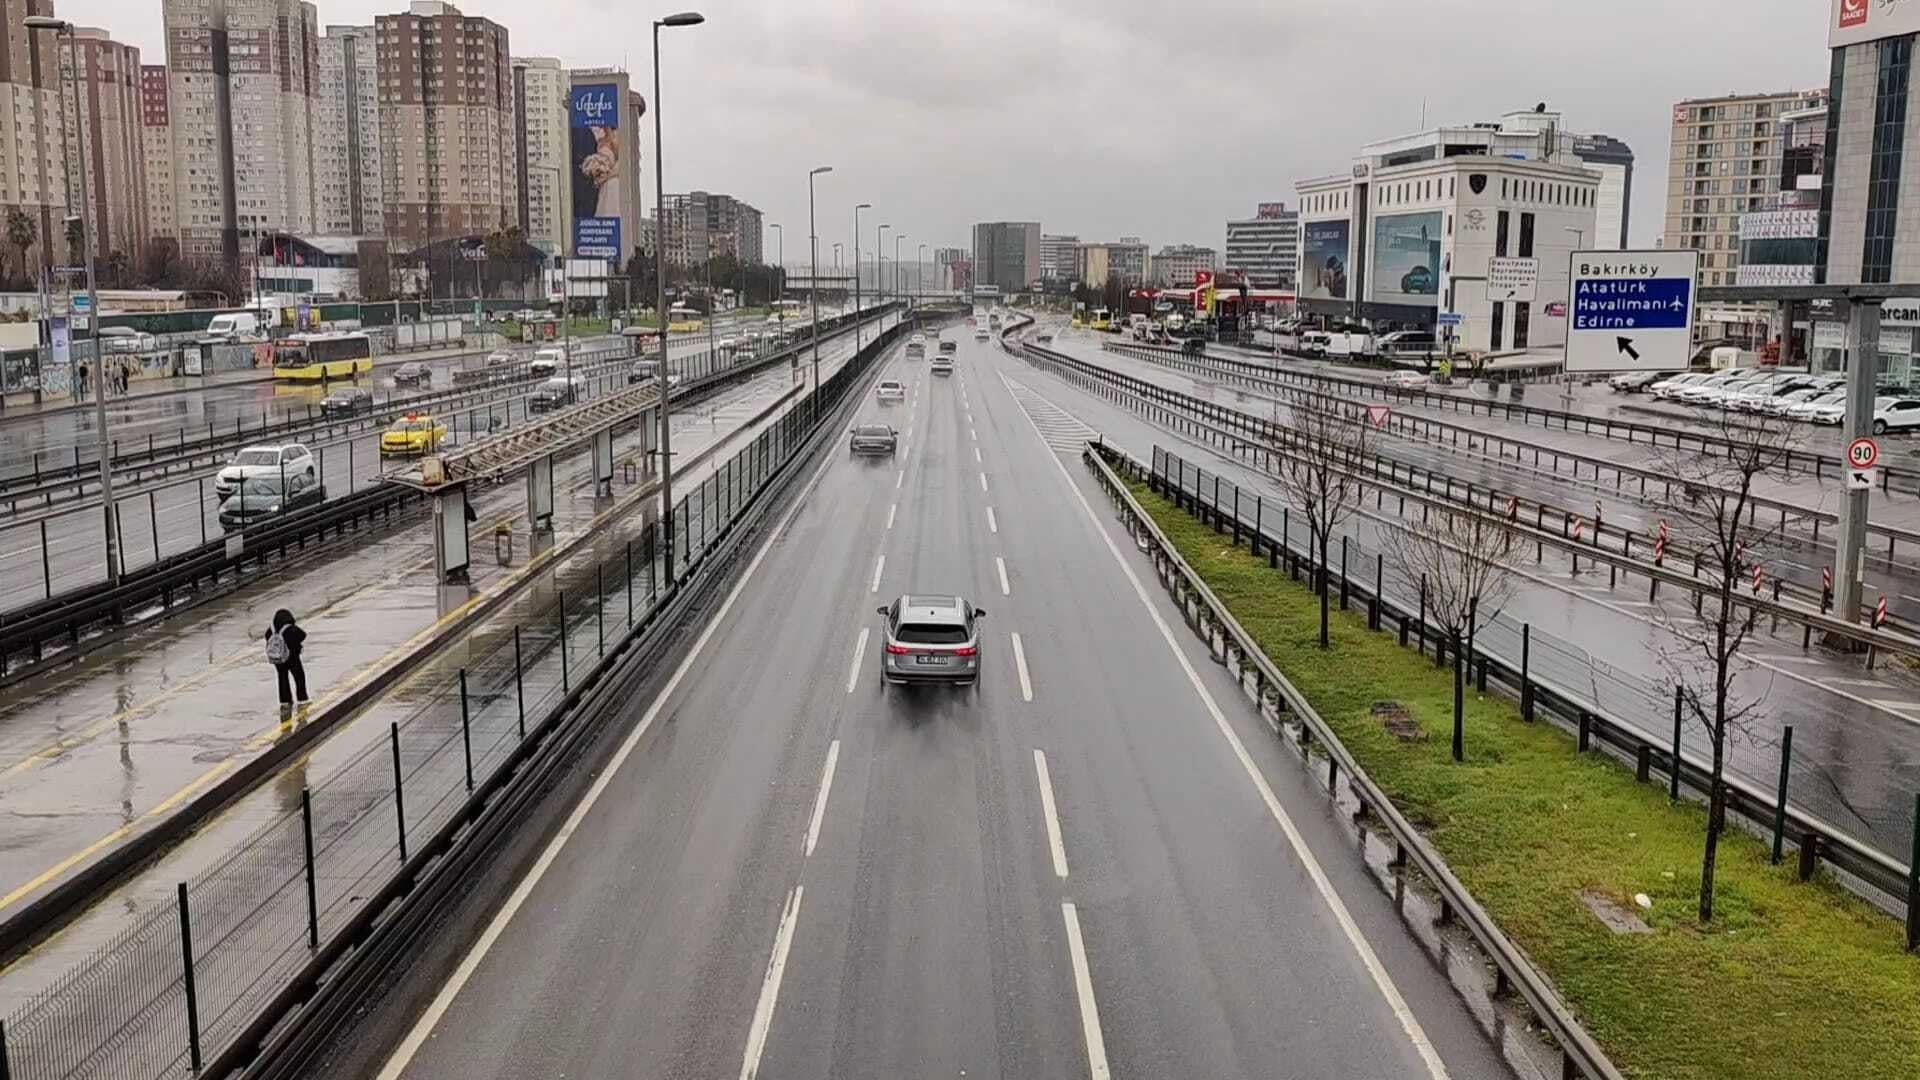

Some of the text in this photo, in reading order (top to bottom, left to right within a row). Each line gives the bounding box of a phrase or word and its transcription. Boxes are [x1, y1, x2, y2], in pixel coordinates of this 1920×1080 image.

[1580, 263, 1659, 277] Bakırköy
[1579, 281, 1647, 294] Atatürk
[1578, 299, 1667, 310] Havalimanı
[1577, 315, 1635, 327] Edirne
[1854, 446, 1871, 460] 90
